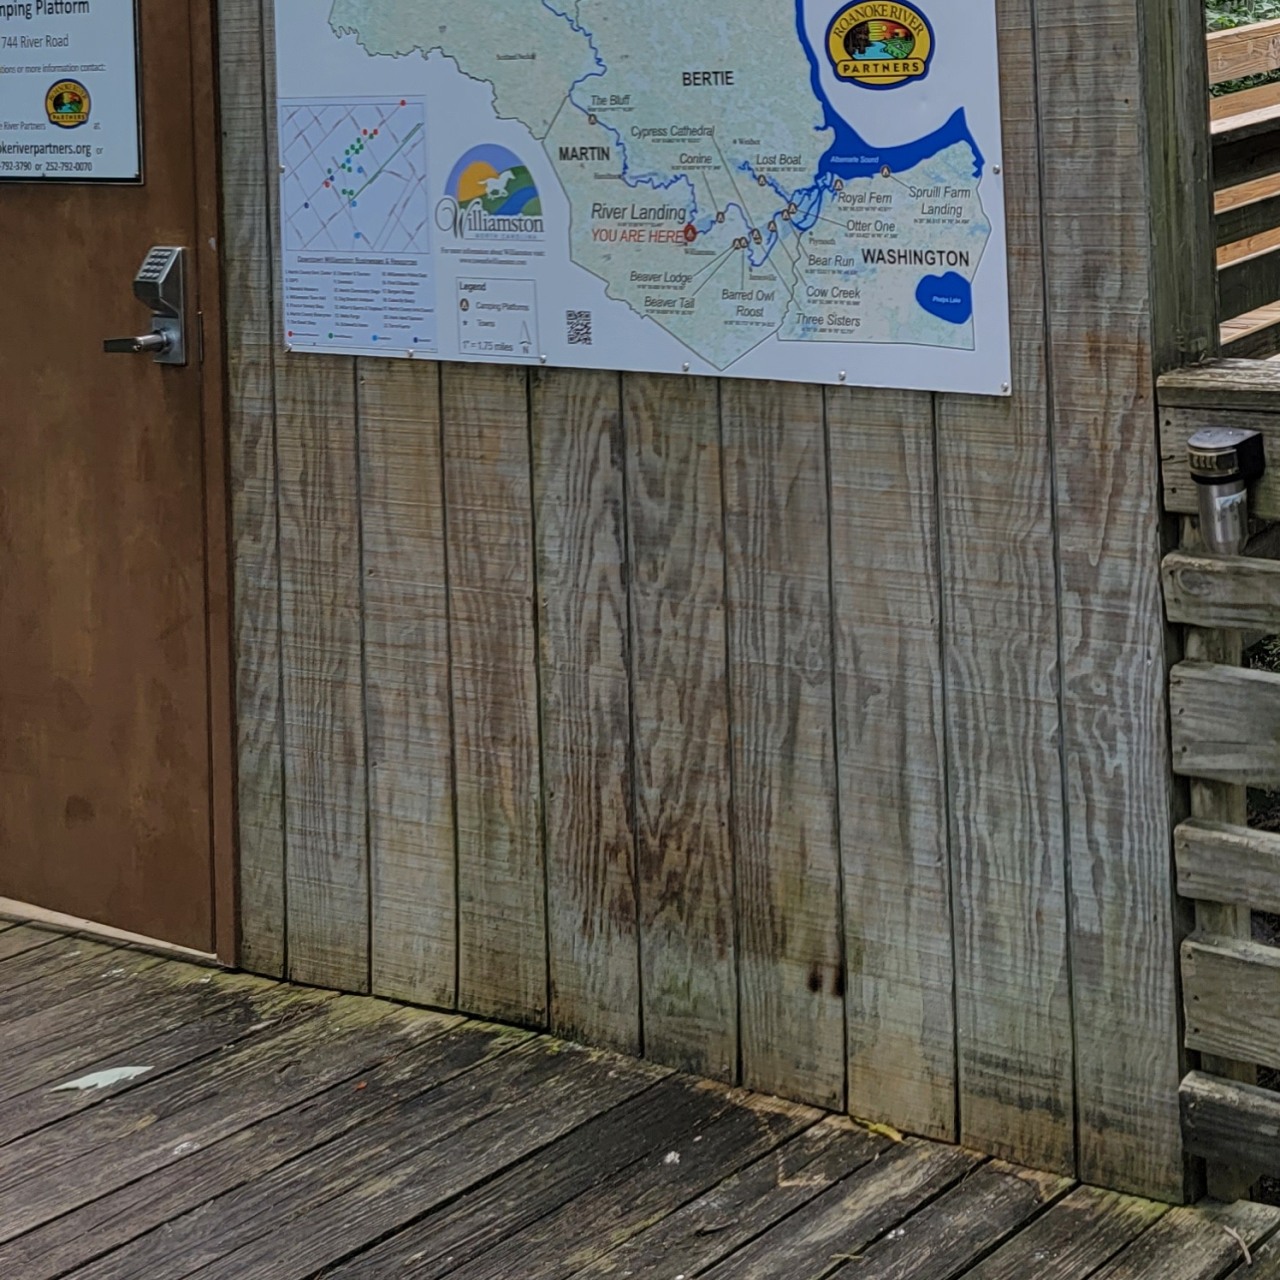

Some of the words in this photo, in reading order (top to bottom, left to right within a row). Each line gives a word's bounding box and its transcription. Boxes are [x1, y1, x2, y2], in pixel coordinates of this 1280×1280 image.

[833, 4, 888, 38] ROANOKE
[889, 5, 924, 37] RIVER
[20, 35, 43, 49] River
[45, 33, 69, 48] Road
[42, 63, 79, 72] information
[843, 62, 919, 73] PARTNERS
[682, 71, 734, 86] BERTIE
[591, 95, 608, 106] The
[609, 94, 631, 106] Bluff
[4, 122, 20, 130] River
[20, 121, 46, 130] Partners
[631, 126, 668, 139] Cypress
[670, 125, 715, 136] Cathedral
[0, 141, 92, 157] keriverpartners.org
[559, 146, 610, 161] MARTIN
[679, 153, 713, 164] Conine
[756, 154, 777, 165] Lost
[779, 154, 802, 165] Boat
[860, 155, 879, 163] Sound
[35, 163, 42, 171] or
[45, 161, 93, 172] 252-792-0070
[838, 192, 866, 205] Royal
[869, 193, 892, 203] Fern
[909, 186, 941, 199] Spruill
[943, 187, 971, 198] Farm
[591, 202, 627, 219] River
[631, 203, 686, 224] Landing
[921, 203, 962, 217] Landing
[435, 197, 545, 239] Williamston
[846, 220, 872, 231] Otter
[874, 220, 895, 231] One
[591, 228, 618, 242] YOU
[620, 229, 646, 242] ARE
[648, 229, 684, 243] HERE
[808, 255, 832, 266] Bear
[834, 255, 854, 267] Run
[861, 248, 970, 267] WASHINGTON
[630, 271, 662, 282] Beaver
[664, 272, 693, 285] Lodge
[459, 282, 486, 292] Legend
[806, 286, 828, 297] Cow
[831, 286, 861, 299] Creek
[721, 289, 753, 300] Barred
[756, 290, 775, 301] Owl
[476, 302, 501, 311] Camping
[502, 303, 529, 311] Platforms
[644, 296, 677, 308] Beaver
[679, 297, 695, 309] Tail
[736, 306, 764, 317] Roost
[477, 320, 495, 328] Towns
[796, 312, 824, 325] Three
[827, 314, 861, 327] Sisters
[478, 341, 493, 351] 1.75
[494, 342, 513, 352] miles
[523, 346, 529, 354] N
